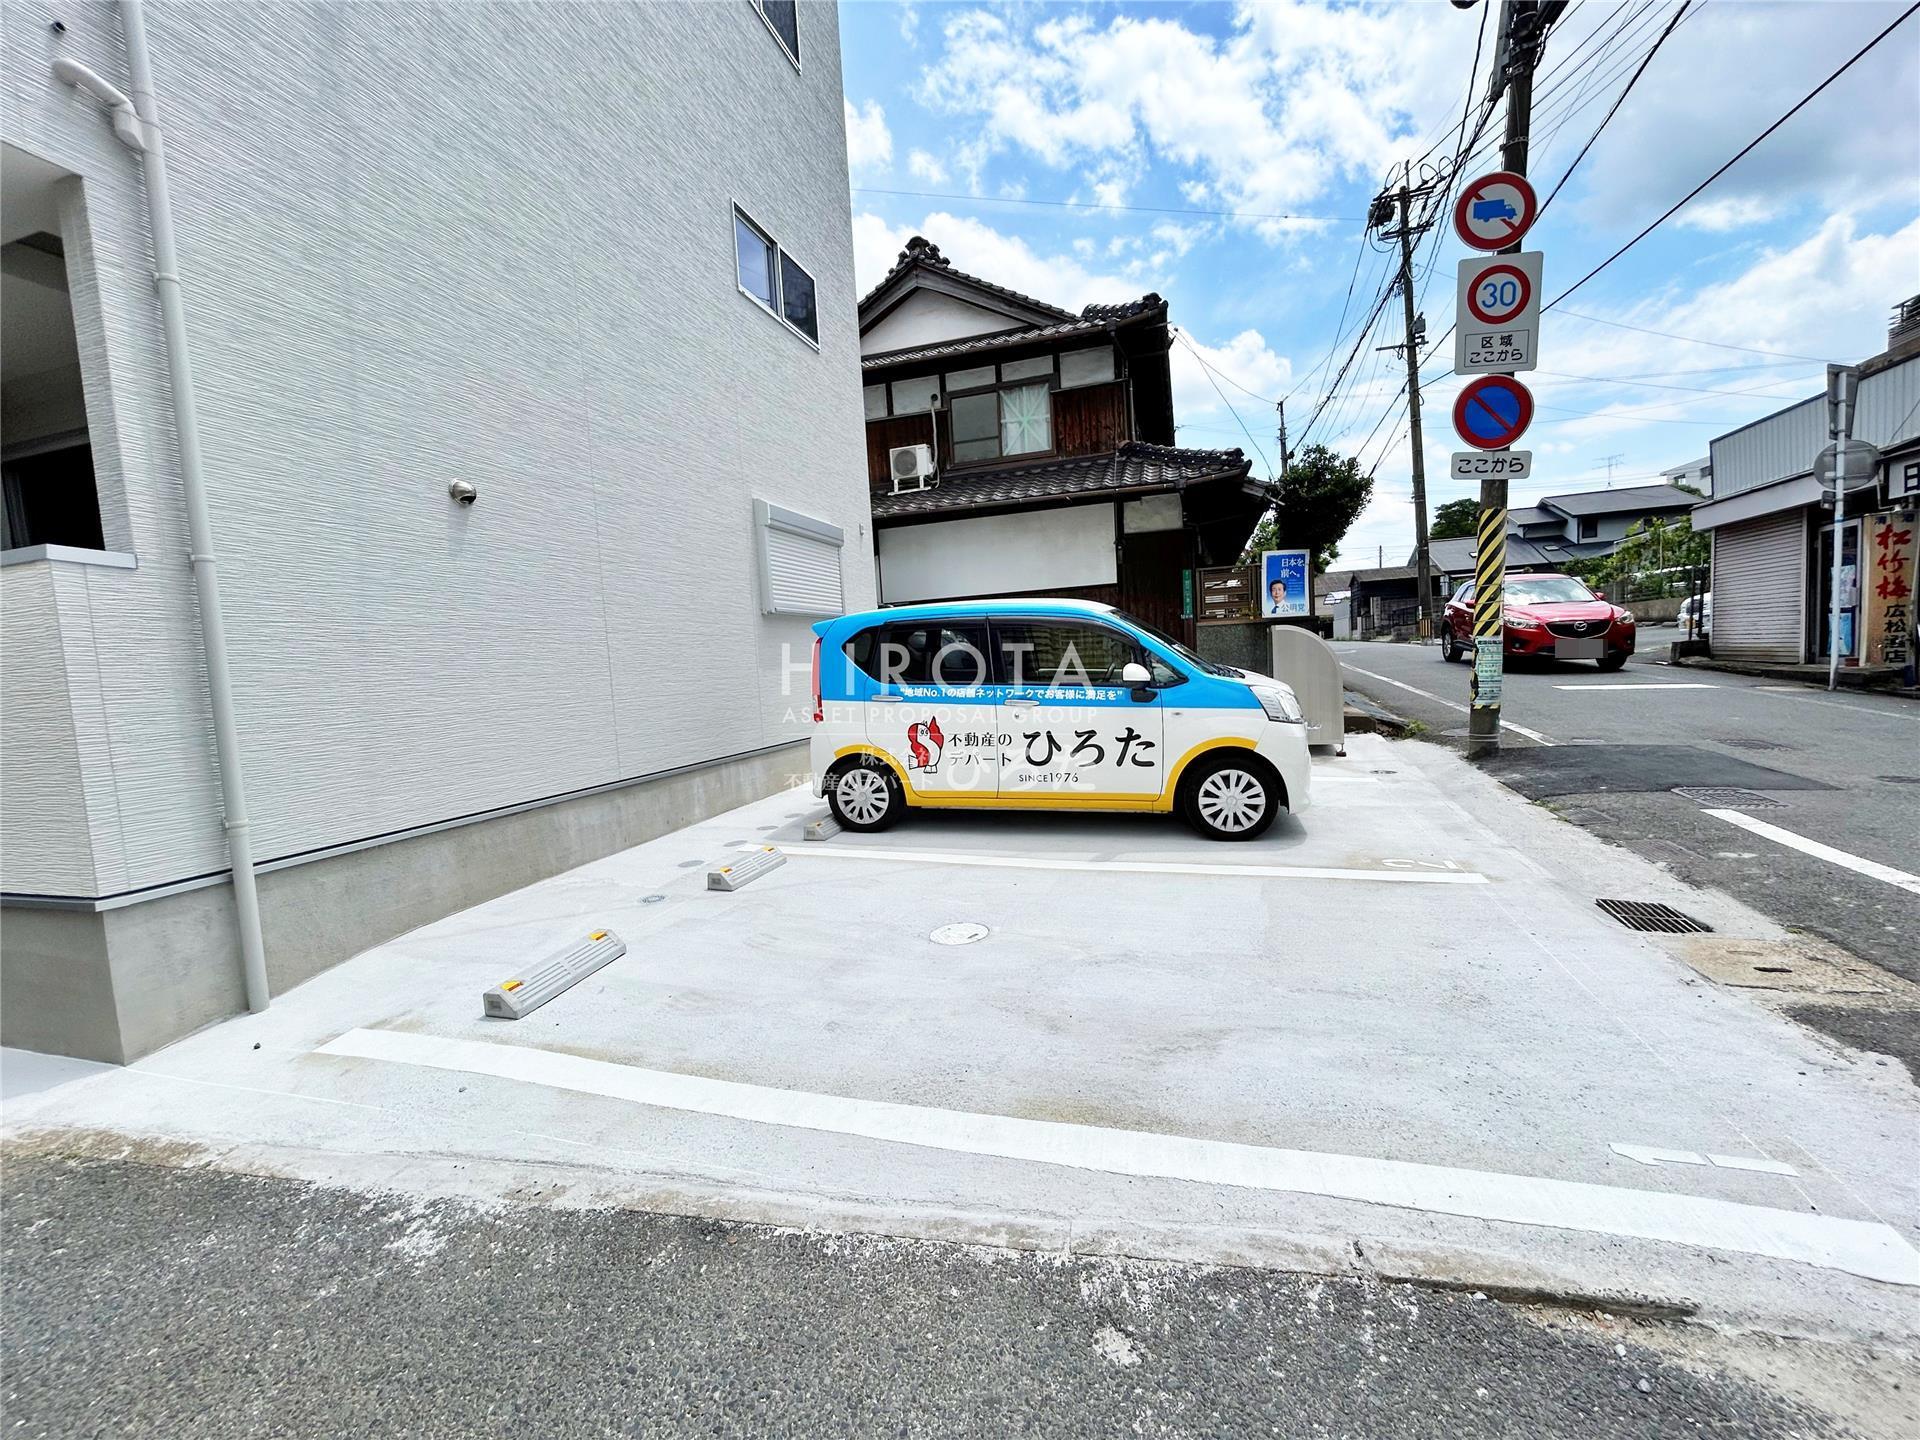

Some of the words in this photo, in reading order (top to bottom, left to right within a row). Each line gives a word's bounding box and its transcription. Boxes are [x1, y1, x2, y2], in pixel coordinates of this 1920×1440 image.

[1481, 281, 1517, 309] 30
[1481, 334, 1513, 349] 区域
[1469, 349, 1523, 364] ここから
[1457, 457, 1524, 474] ここから
[1875, 523, 1912, 599] 松竹梅
[1281, 603, 1305, 613] 公明党
[948, 732, 1012, 747] 不動産の
[1023, 726, 1156, 768] ひろた
[949, 752, 1012, 767] デパート
